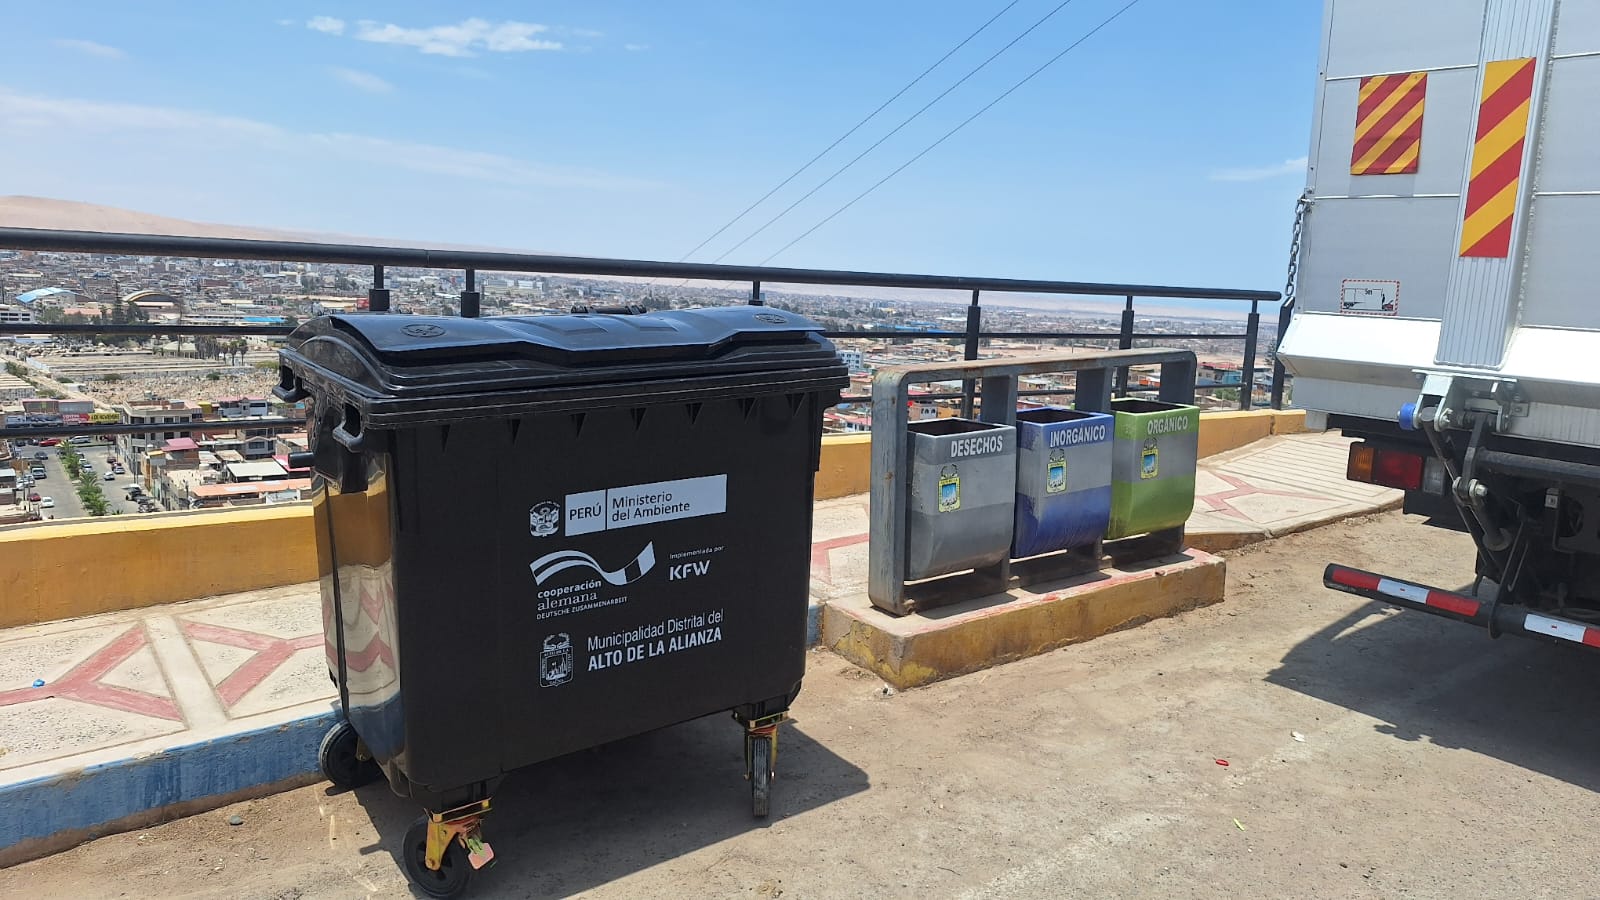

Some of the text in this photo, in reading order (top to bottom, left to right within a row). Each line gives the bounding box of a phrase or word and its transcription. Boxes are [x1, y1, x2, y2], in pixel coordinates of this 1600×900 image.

[1147, 415, 1189, 435] ORGÁNICO
[951, 435, 1003, 458] DESECHOS
[1050, 424, 1106, 448] INORGÁNICO
[612, 491, 673, 509] Ministerio
[569, 502, 602, 521] PERÚ
[612, 501, 690, 522] del Ambiente
[537, 580, 602, 599] cooperación
[536, 596, 628, 620] DEUTSCHE ZUSAMMENARBEIT
[537, 592, 598, 611] alemana
[587, 608, 724, 652] Municipalidad Distrital del
[588, 649, 622, 672] ALTO
[627, 644, 645, 663] DE
[648, 640, 665, 657] LA
[669, 626, 722, 652] ALIANZA
